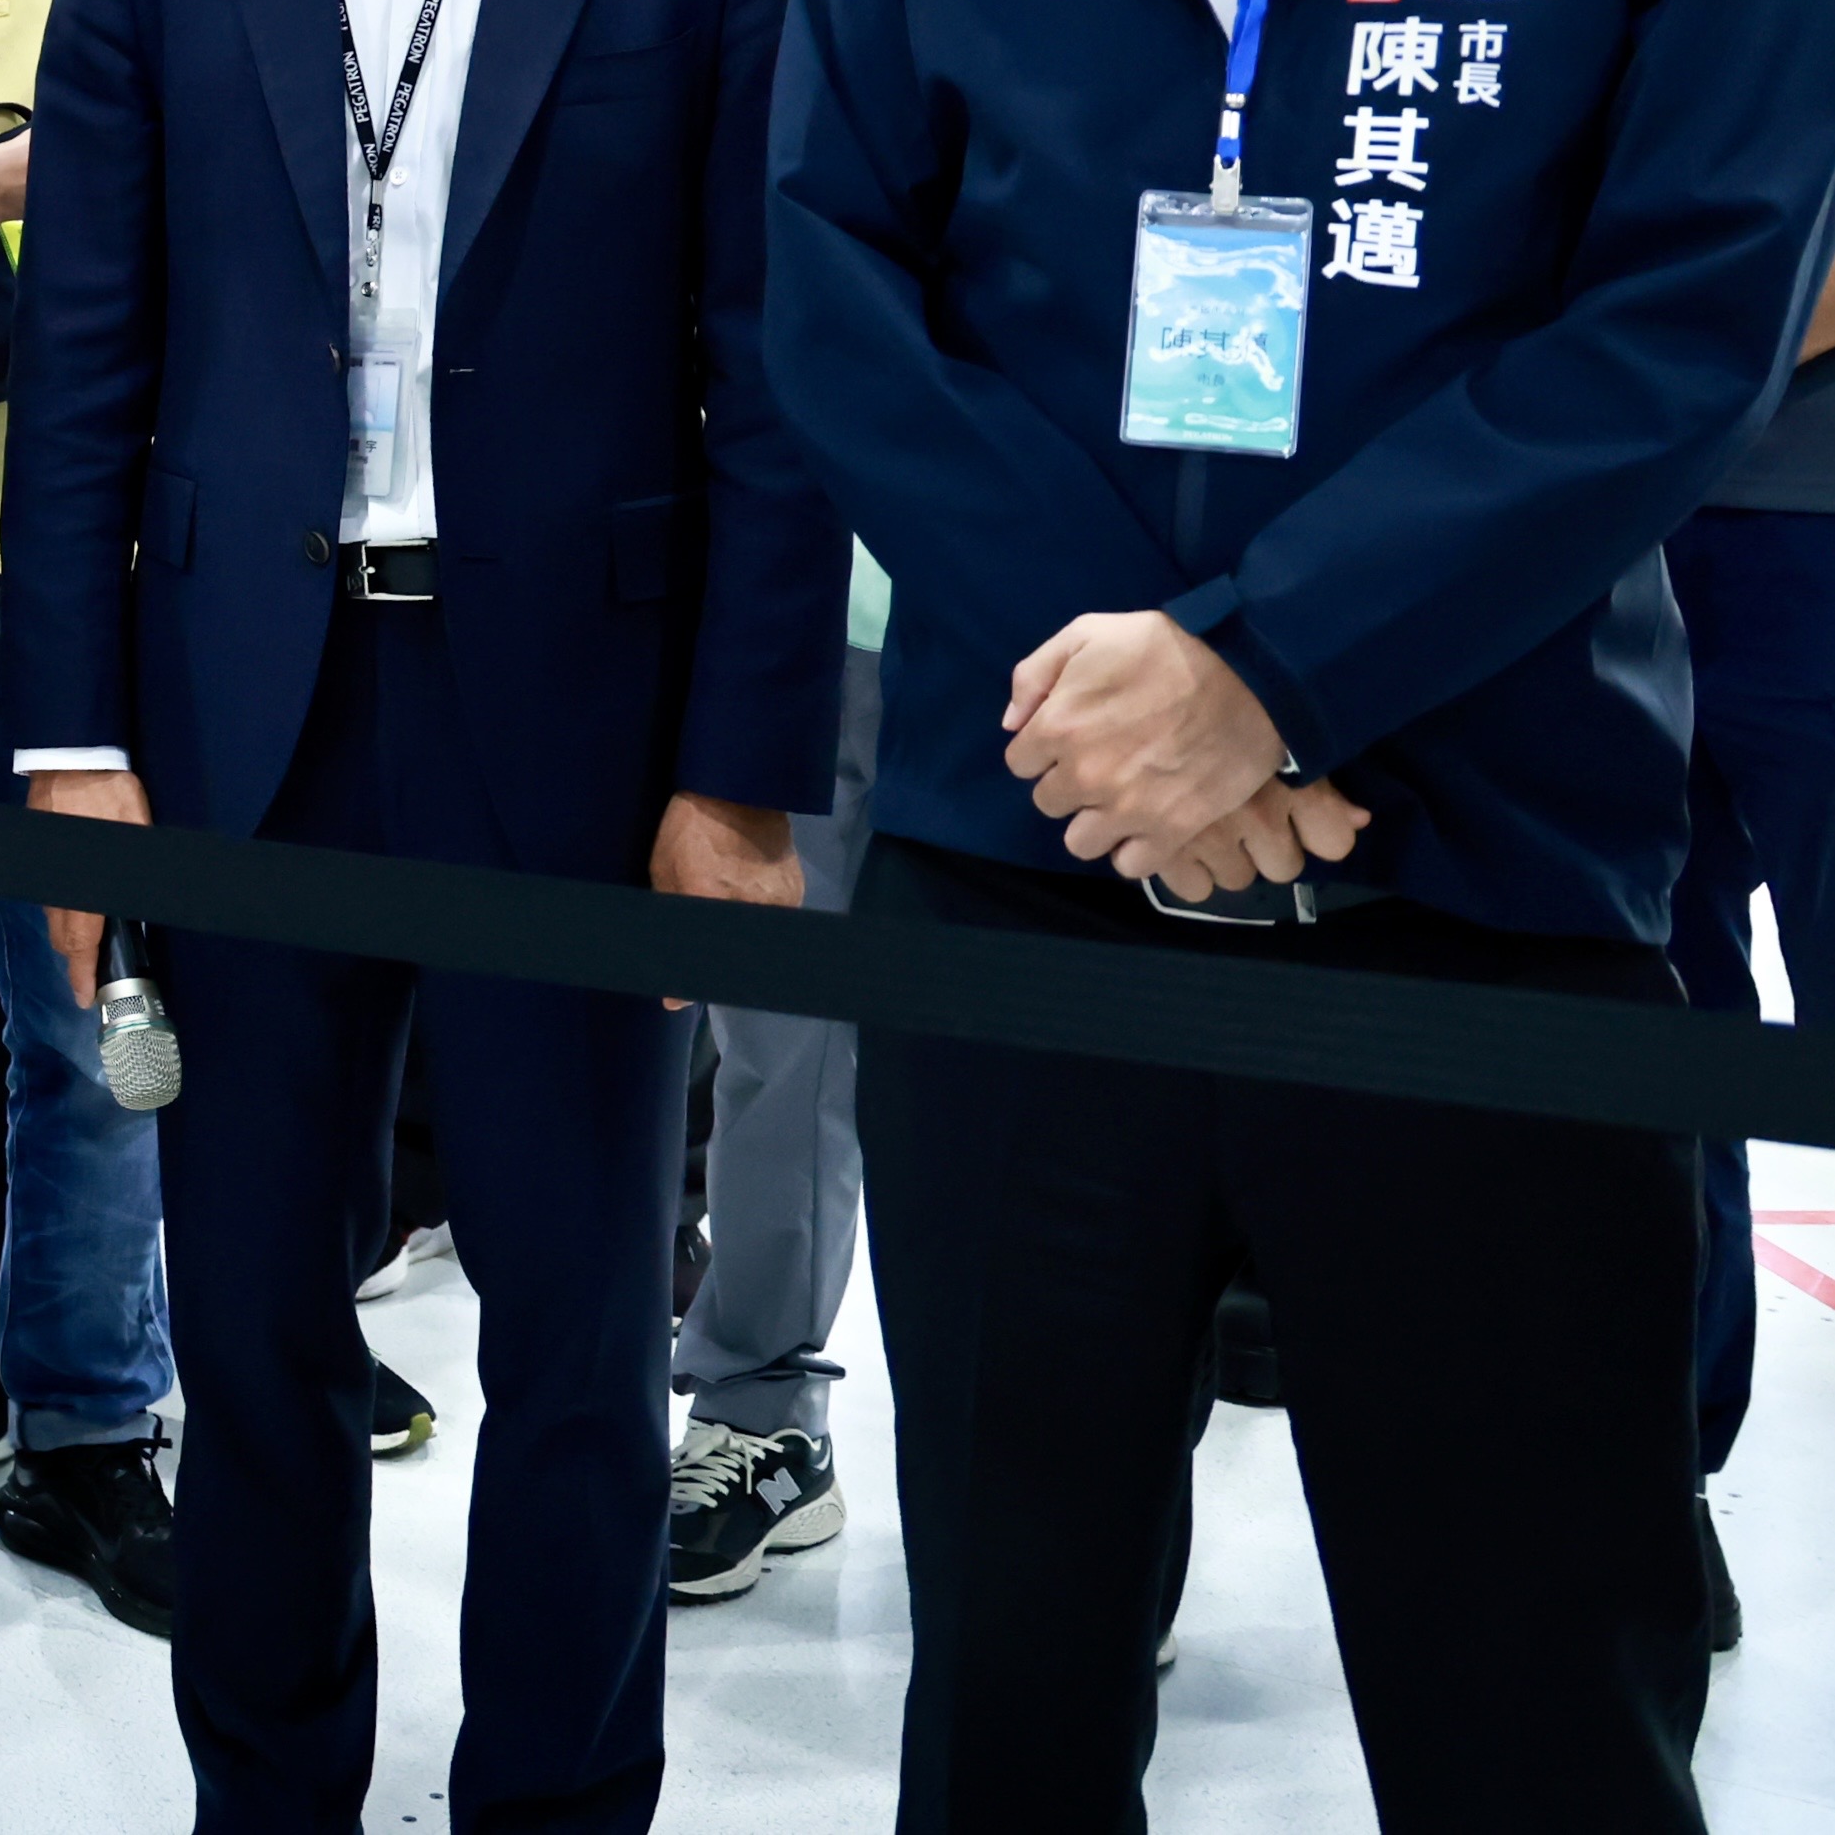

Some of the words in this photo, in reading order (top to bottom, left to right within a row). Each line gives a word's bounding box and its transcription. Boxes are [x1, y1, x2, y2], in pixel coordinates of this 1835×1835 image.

[343, 51, 370, 123] PEGATRON
[1453, 19, 1508, 108] 市長
[382, 81, 413, 153] PEGATRON
[1322, 16, 1444, 288] 陳其邁
